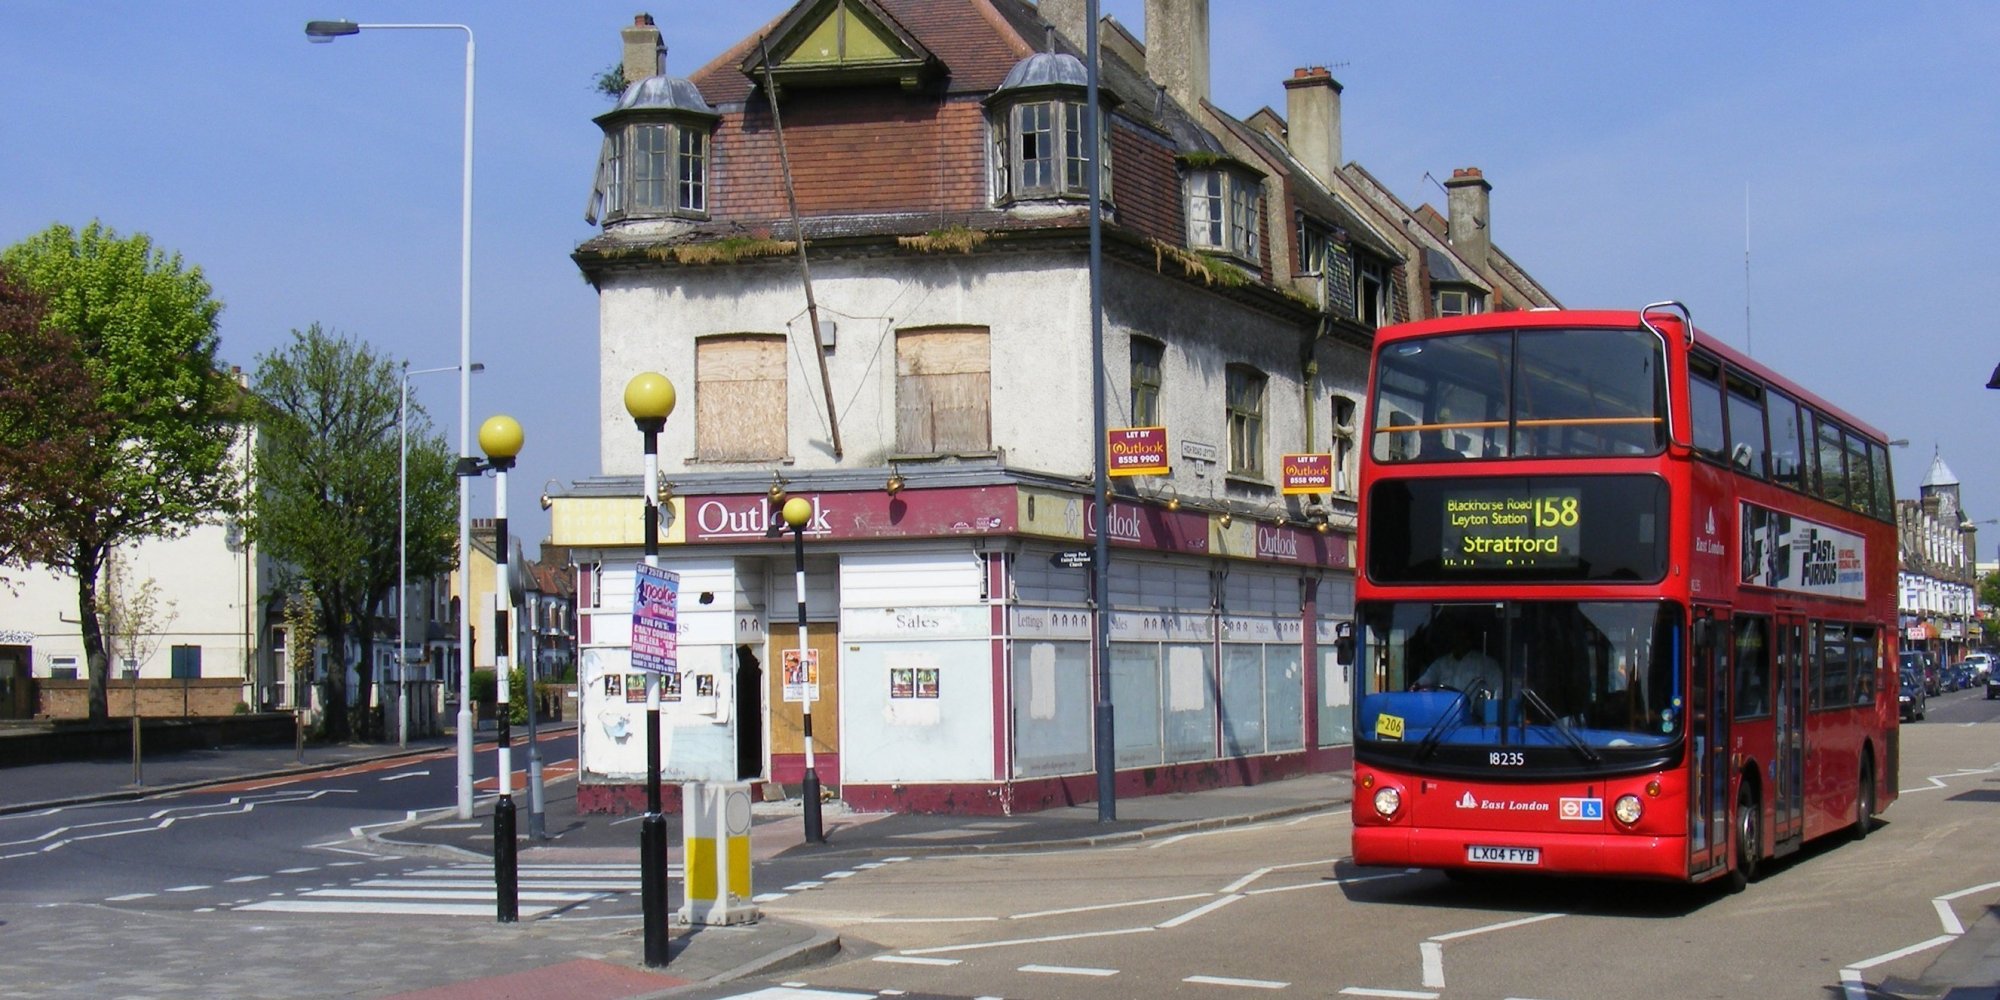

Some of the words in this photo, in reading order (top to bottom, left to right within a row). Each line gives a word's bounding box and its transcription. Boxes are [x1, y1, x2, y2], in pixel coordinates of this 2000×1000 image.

[1126, 431, 1138, 439] LET
[1140, 430, 1150, 438] BY
[1113, 441, 1164, 455] Outlook
[1118, 456, 1138, 464] 8558
[1140, 454, 1160, 463] 9900
[1285, 465, 1329, 476] Outlook
[1308, 476, 1325, 484] 9900
[1447, 499, 1503, 511] Blackhorse
[1506, 498, 1532, 510] Road
[1535, 496, 1579, 527] 158
[1452, 513, 1488, 528] Leyton
[1491, 512, 1527, 524] Station
[1259, 527, 1297, 555] Outlook
[1463, 535, 1558, 552] Stratford
[1696, 537, 1708, 552] East
[1708, 539, 1725, 556] London
[637, 564, 649, 575] SAT
[1802, 552, 1837, 586] FURIOUS
[640, 616, 654, 628] LIVE
[896, 614, 939, 629] Sales
[1017, 612, 1043, 630] Lettings
[1385, 717, 1402, 732] 206
[1490, 752, 1524, 766] 18235
[1481, 800, 1505, 810] East
[1508, 801, 1549, 811] London
[1473, 848, 1506, 861] LX04
[1509, 850, 1534, 862] FYB
